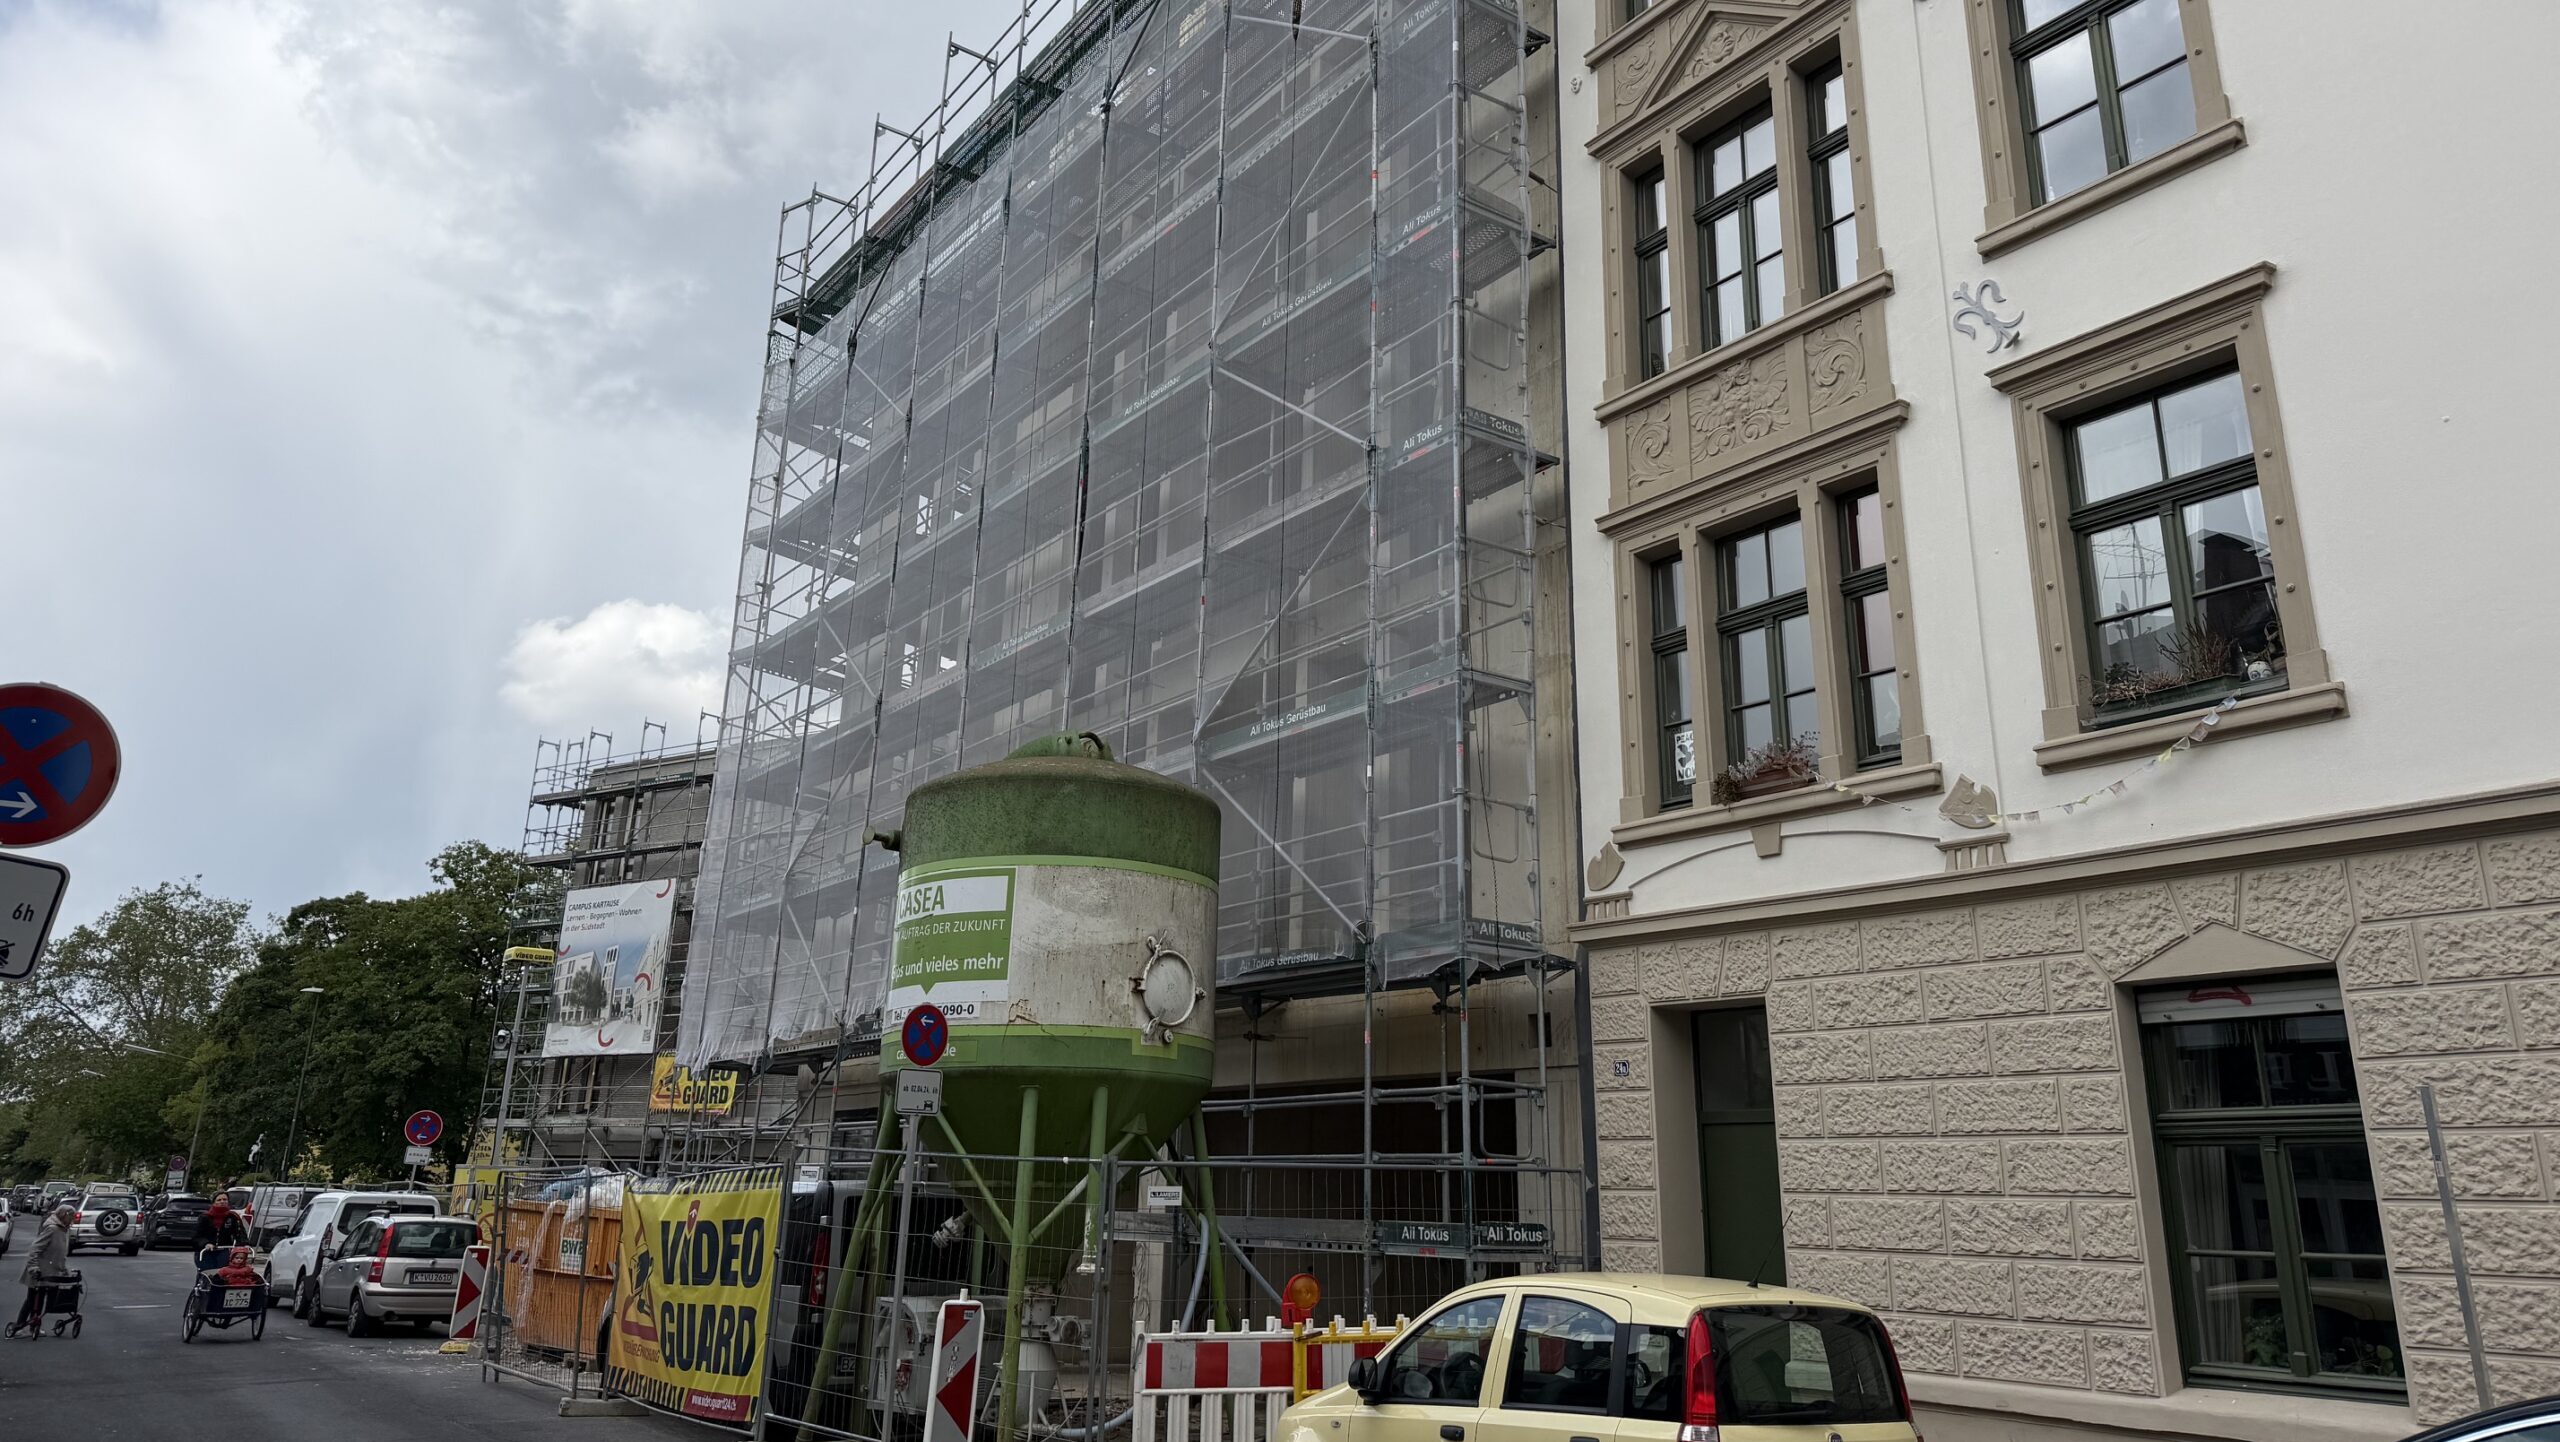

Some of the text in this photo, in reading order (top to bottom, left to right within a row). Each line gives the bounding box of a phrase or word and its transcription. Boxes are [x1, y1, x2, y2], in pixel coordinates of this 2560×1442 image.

[1416, 424, 1443, 443] Tokus
[568, 899, 620, 912] CAMPUS KARTAUSE
[900, 885, 944, 919] CASEA
[566, 914, 586, 922] Lernen
[619, 908, 642, 916] Wohnen
[570, 924, 580, 932] der
[932, 921, 951, 935] DER
[953, 919, 1005, 933] ZUKUNFT
[1480, 922, 1533, 943] Ali Tokus
[905, 958, 923, 977] und
[925, 954, 959, 973] vieles
[963, 952, 1004, 971] mehr
[1401, 1226, 1450, 1242] Ali Tokus
[1487, 1226, 1543, 1242] Ali Tokus
[661, 1214, 765, 1288] VIDEO
[661, 1301, 758, 1377] GUARD
